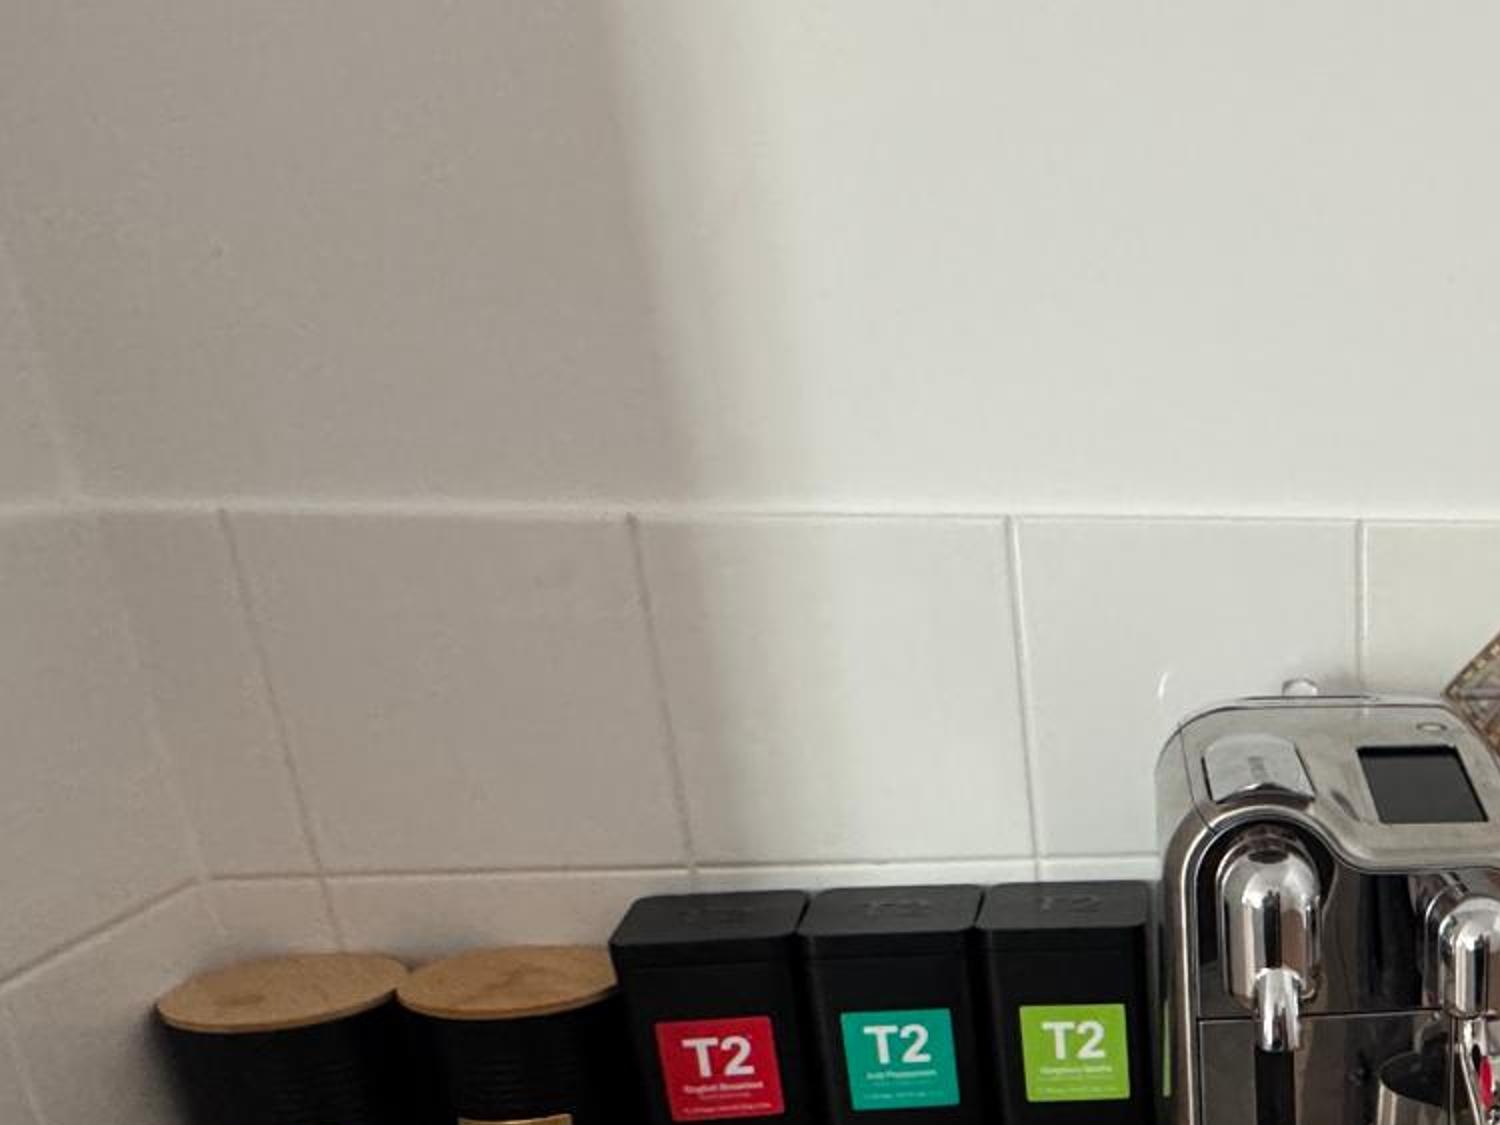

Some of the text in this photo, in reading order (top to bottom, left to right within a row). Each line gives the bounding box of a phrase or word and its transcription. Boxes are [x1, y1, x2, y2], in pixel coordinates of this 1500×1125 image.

[681, 1035, 755, 1078] T2
[863, 1023, 932, 1065] T2
[1041, 1020, 1106, 1060] T2
